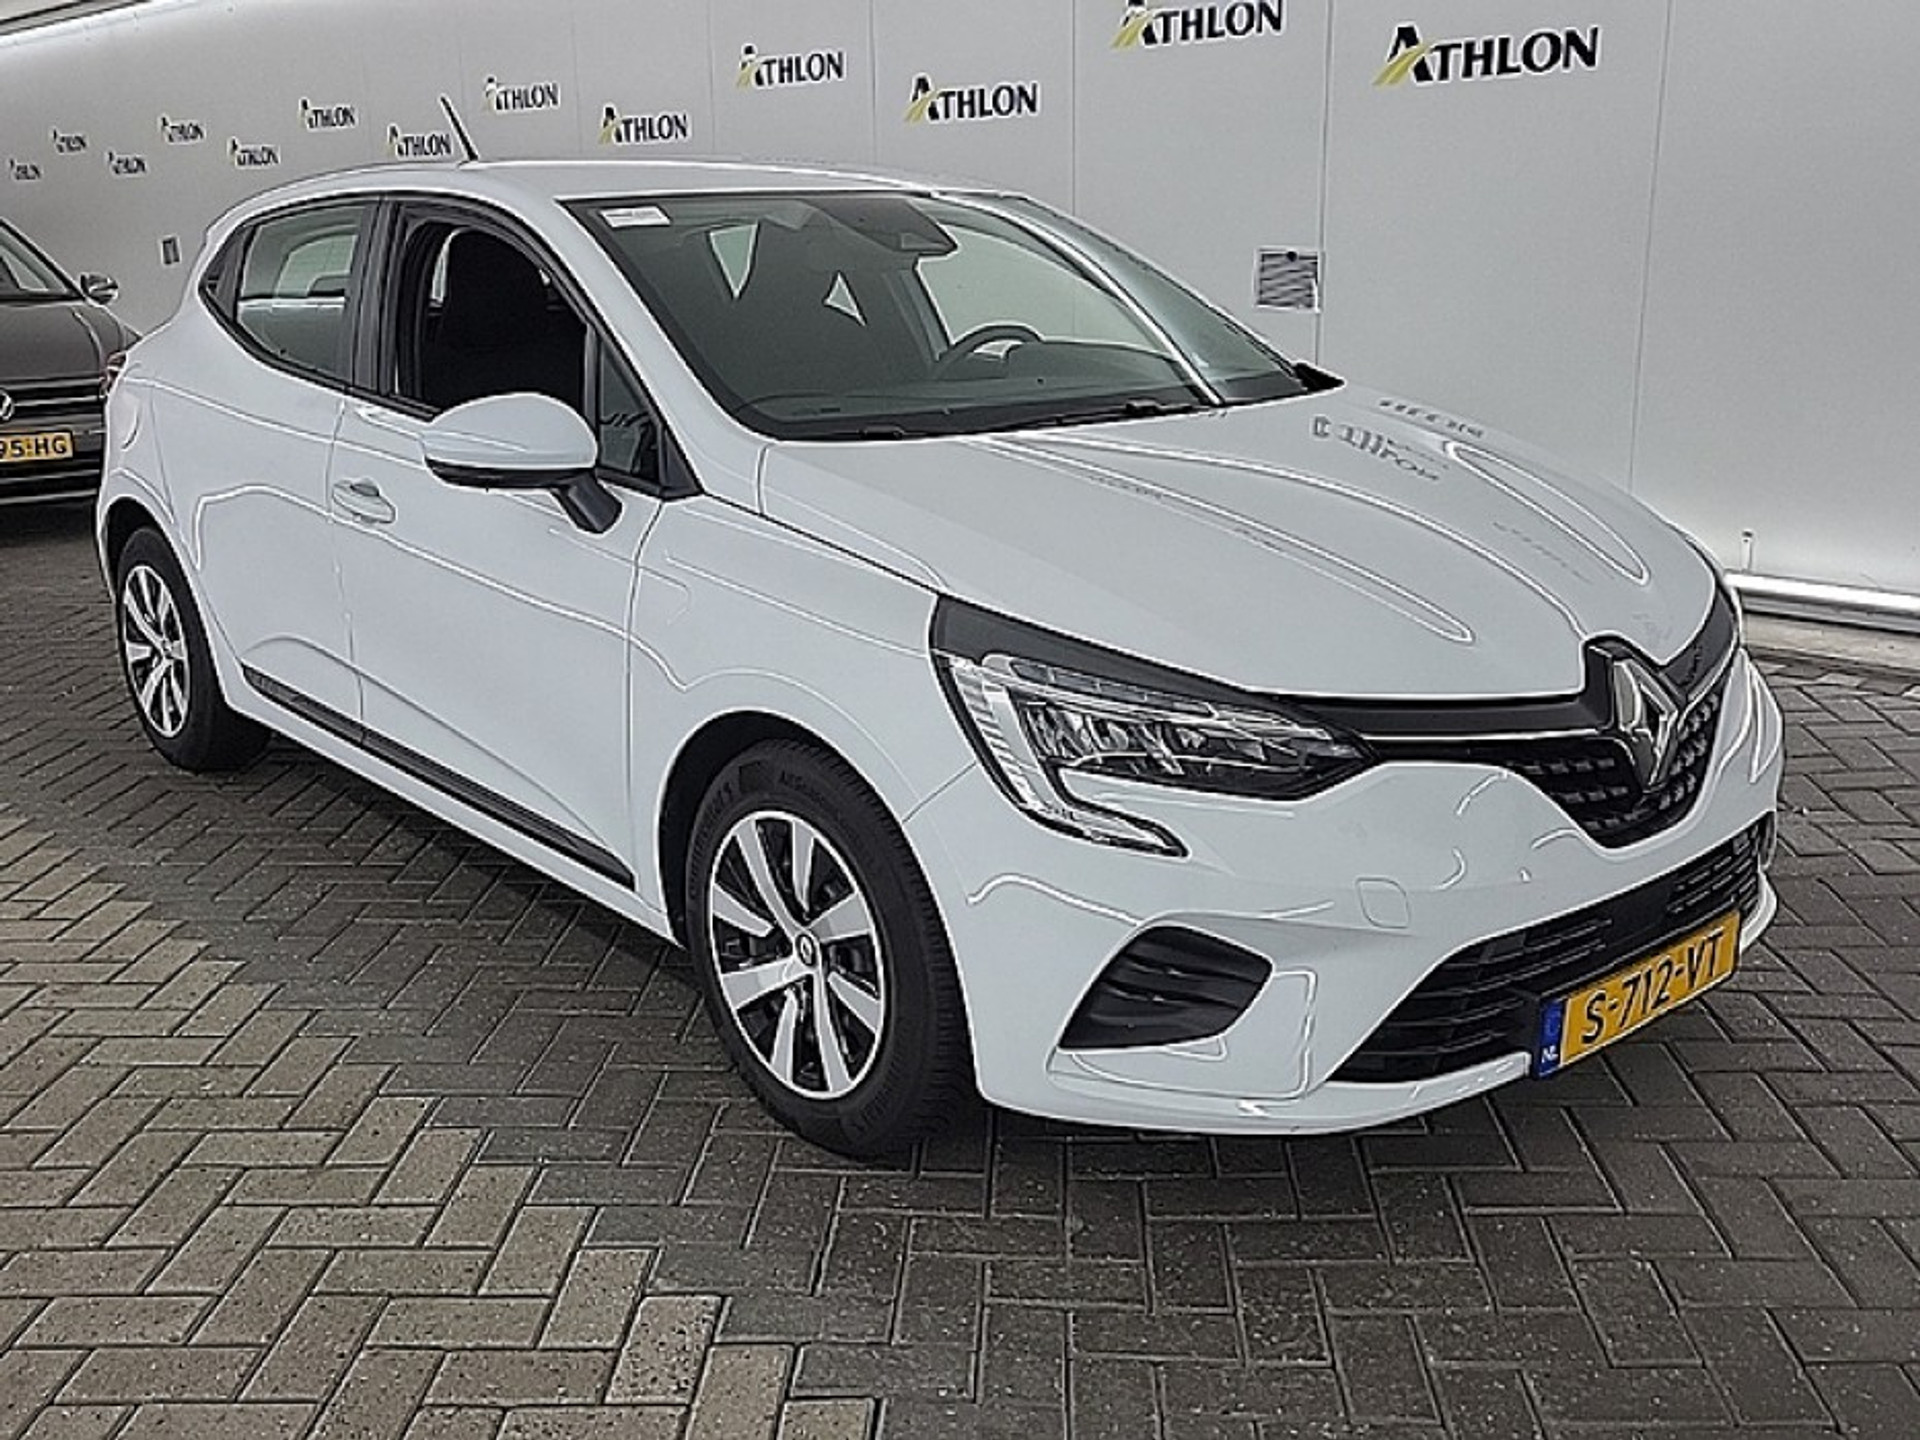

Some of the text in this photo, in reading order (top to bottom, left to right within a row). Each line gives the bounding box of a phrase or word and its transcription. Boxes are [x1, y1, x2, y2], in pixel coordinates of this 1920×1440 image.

[1110, 0, 1283, 48] ATHLON
[737, 45, 844, 87] ATHLON
[1373, 26, 1599, 85] ATHLON
[485, 76, 559, 111] ATHLON
[906, 76, 1038, 122] ATHLON
[387, 125, 451, 157] ATHLON
[600, 106, 688, 144] ATHLON
[1581, 930, 1724, 1044] S-712-VT
